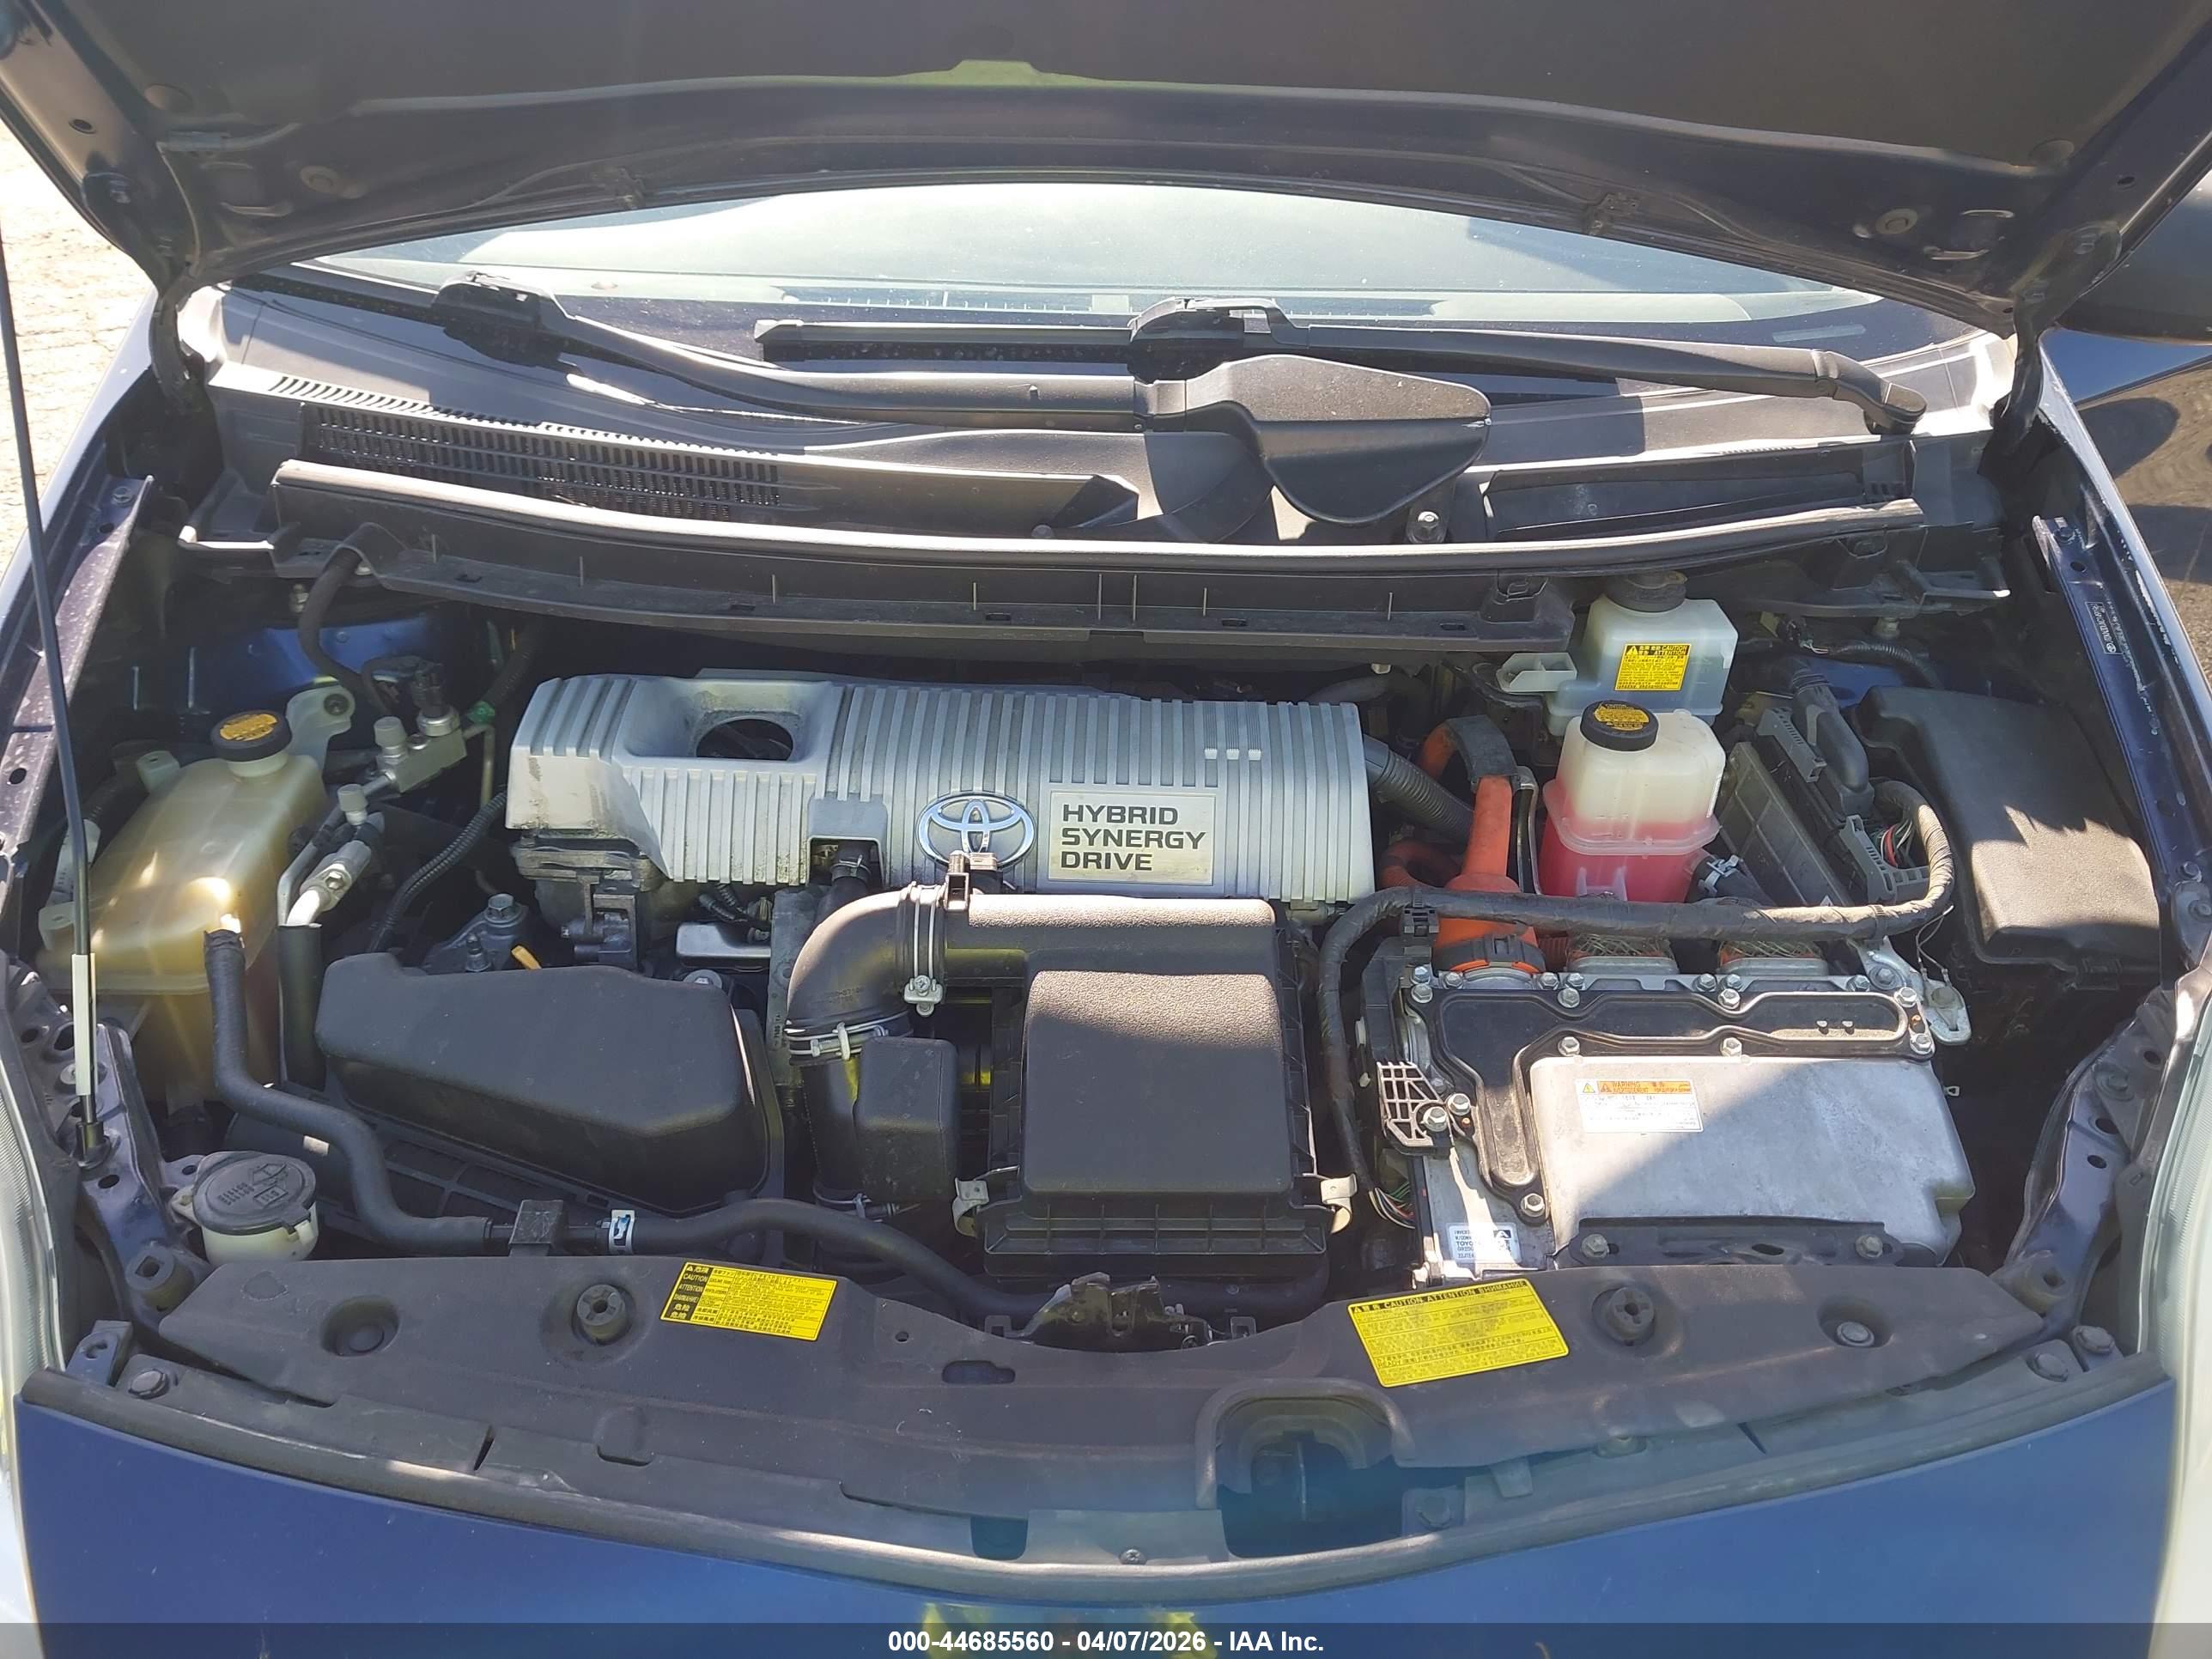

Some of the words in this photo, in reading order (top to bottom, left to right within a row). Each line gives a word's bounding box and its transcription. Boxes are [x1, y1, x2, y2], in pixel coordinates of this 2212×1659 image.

[1062, 804, 1179, 825] HYBRID
[1061, 827, 1206, 850] SYNERGY
[1060, 851, 1153, 872] DRIVE
[678, 1284, 704, 1293] ATTENTION
[683, 1273, 708, 1283] CAUTION
[1384, 1296, 1422, 1309] CAUTION
[1426, 1288, 1475, 1303] ATTENTION
